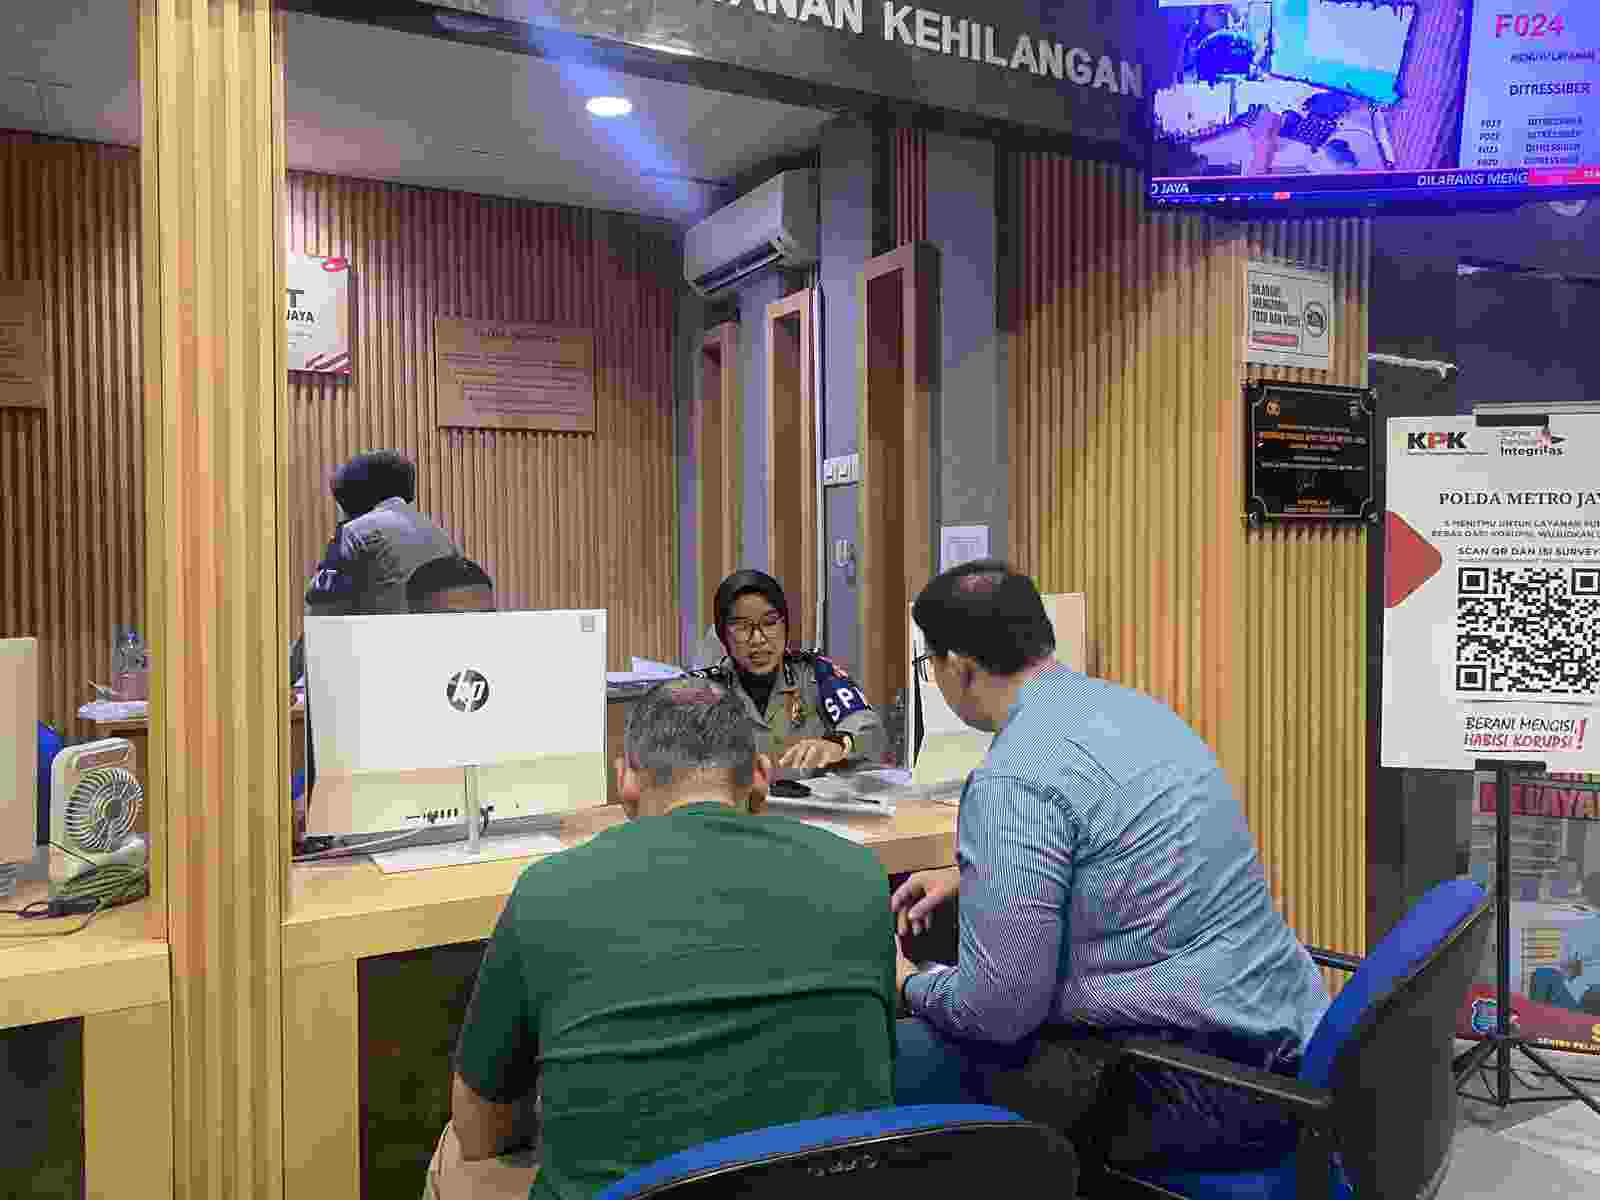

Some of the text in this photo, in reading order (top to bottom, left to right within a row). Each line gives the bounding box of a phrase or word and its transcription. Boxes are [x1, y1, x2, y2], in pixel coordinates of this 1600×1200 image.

[1495, 14, 1565, 38] F024
[883, 0, 1144, 98] KEHILANGAN
[1416, 173, 1485, 187] DILARANG
[1162, 183, 1190, 195] JAYA
[1407, 432, 1467, 450] KPK
[1440, 492, 1501, 505] POLDA
[1507, 492, 1573, 505] METRO
[1457, 546, 1489, 556] SCAN
[1511, 546, 1537, 556] DAN
[1464, 716, 1515, 730] BERANI
[1463, 733, 1508, 747] HABISI
